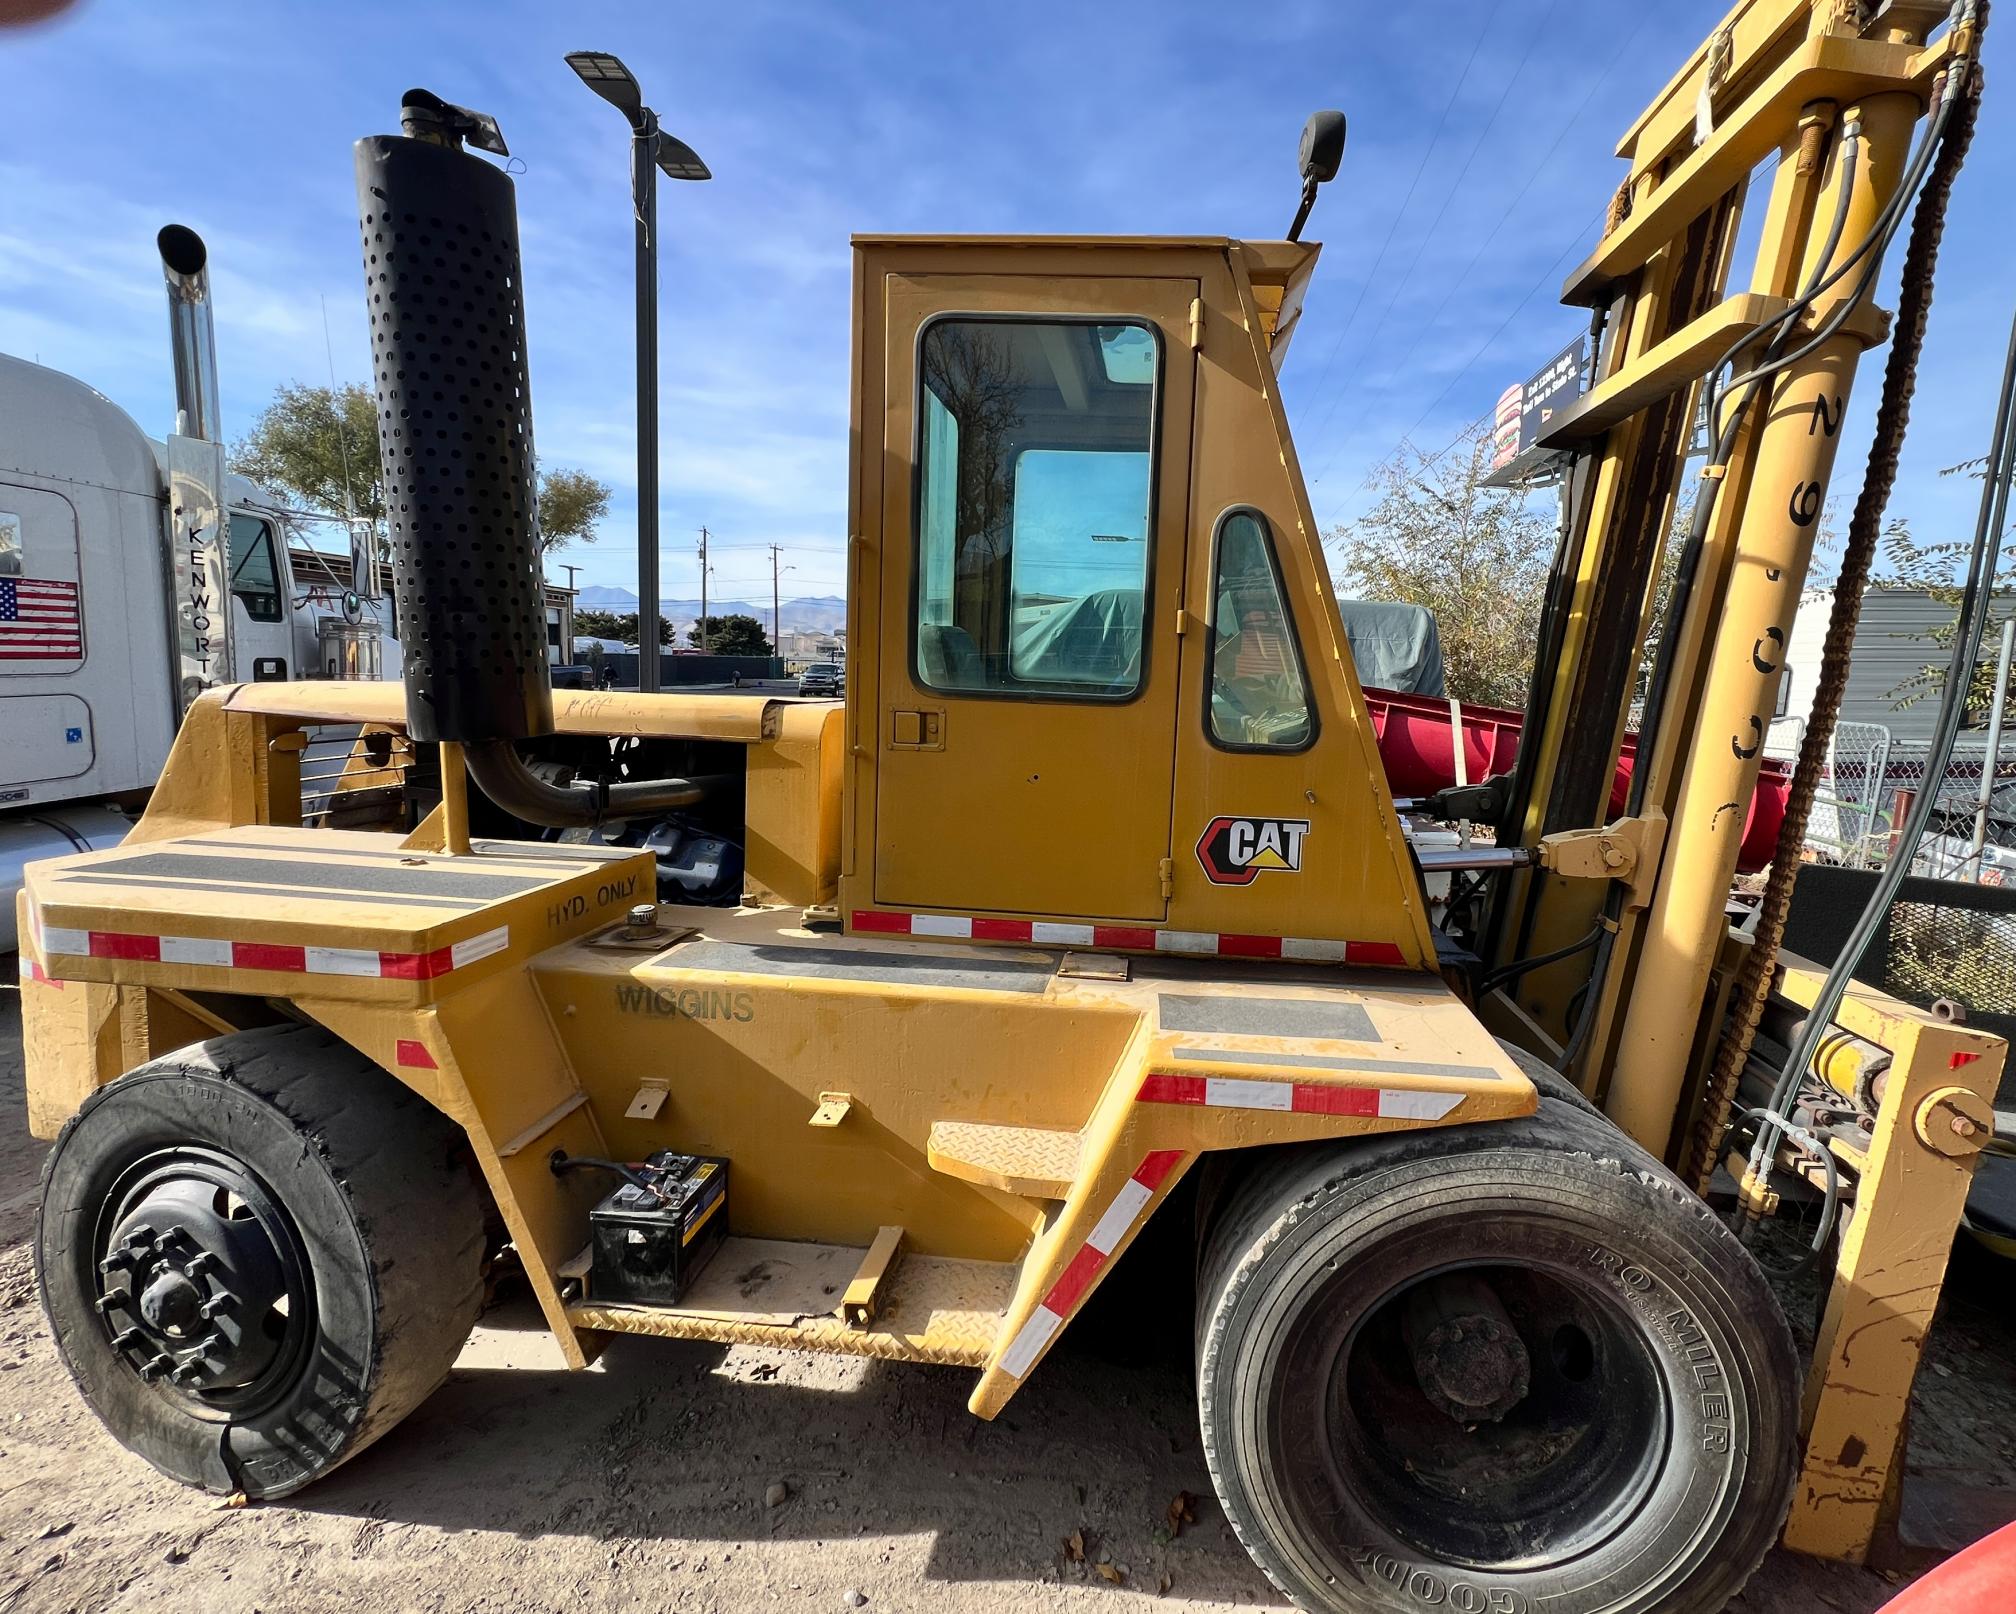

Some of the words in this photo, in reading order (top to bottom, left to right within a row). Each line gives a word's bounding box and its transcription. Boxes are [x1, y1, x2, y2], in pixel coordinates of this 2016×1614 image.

[189, 528, 212, 693] KENWORTH
[1228, 820, 1308, 869] CAT
[547, 895, 590, 928] HYD.
[597, 875, 637, 907] ONLY
[616, 984, 755, 1022] WIGGINS
[1665, 1307, 1729, 1455] MILER
